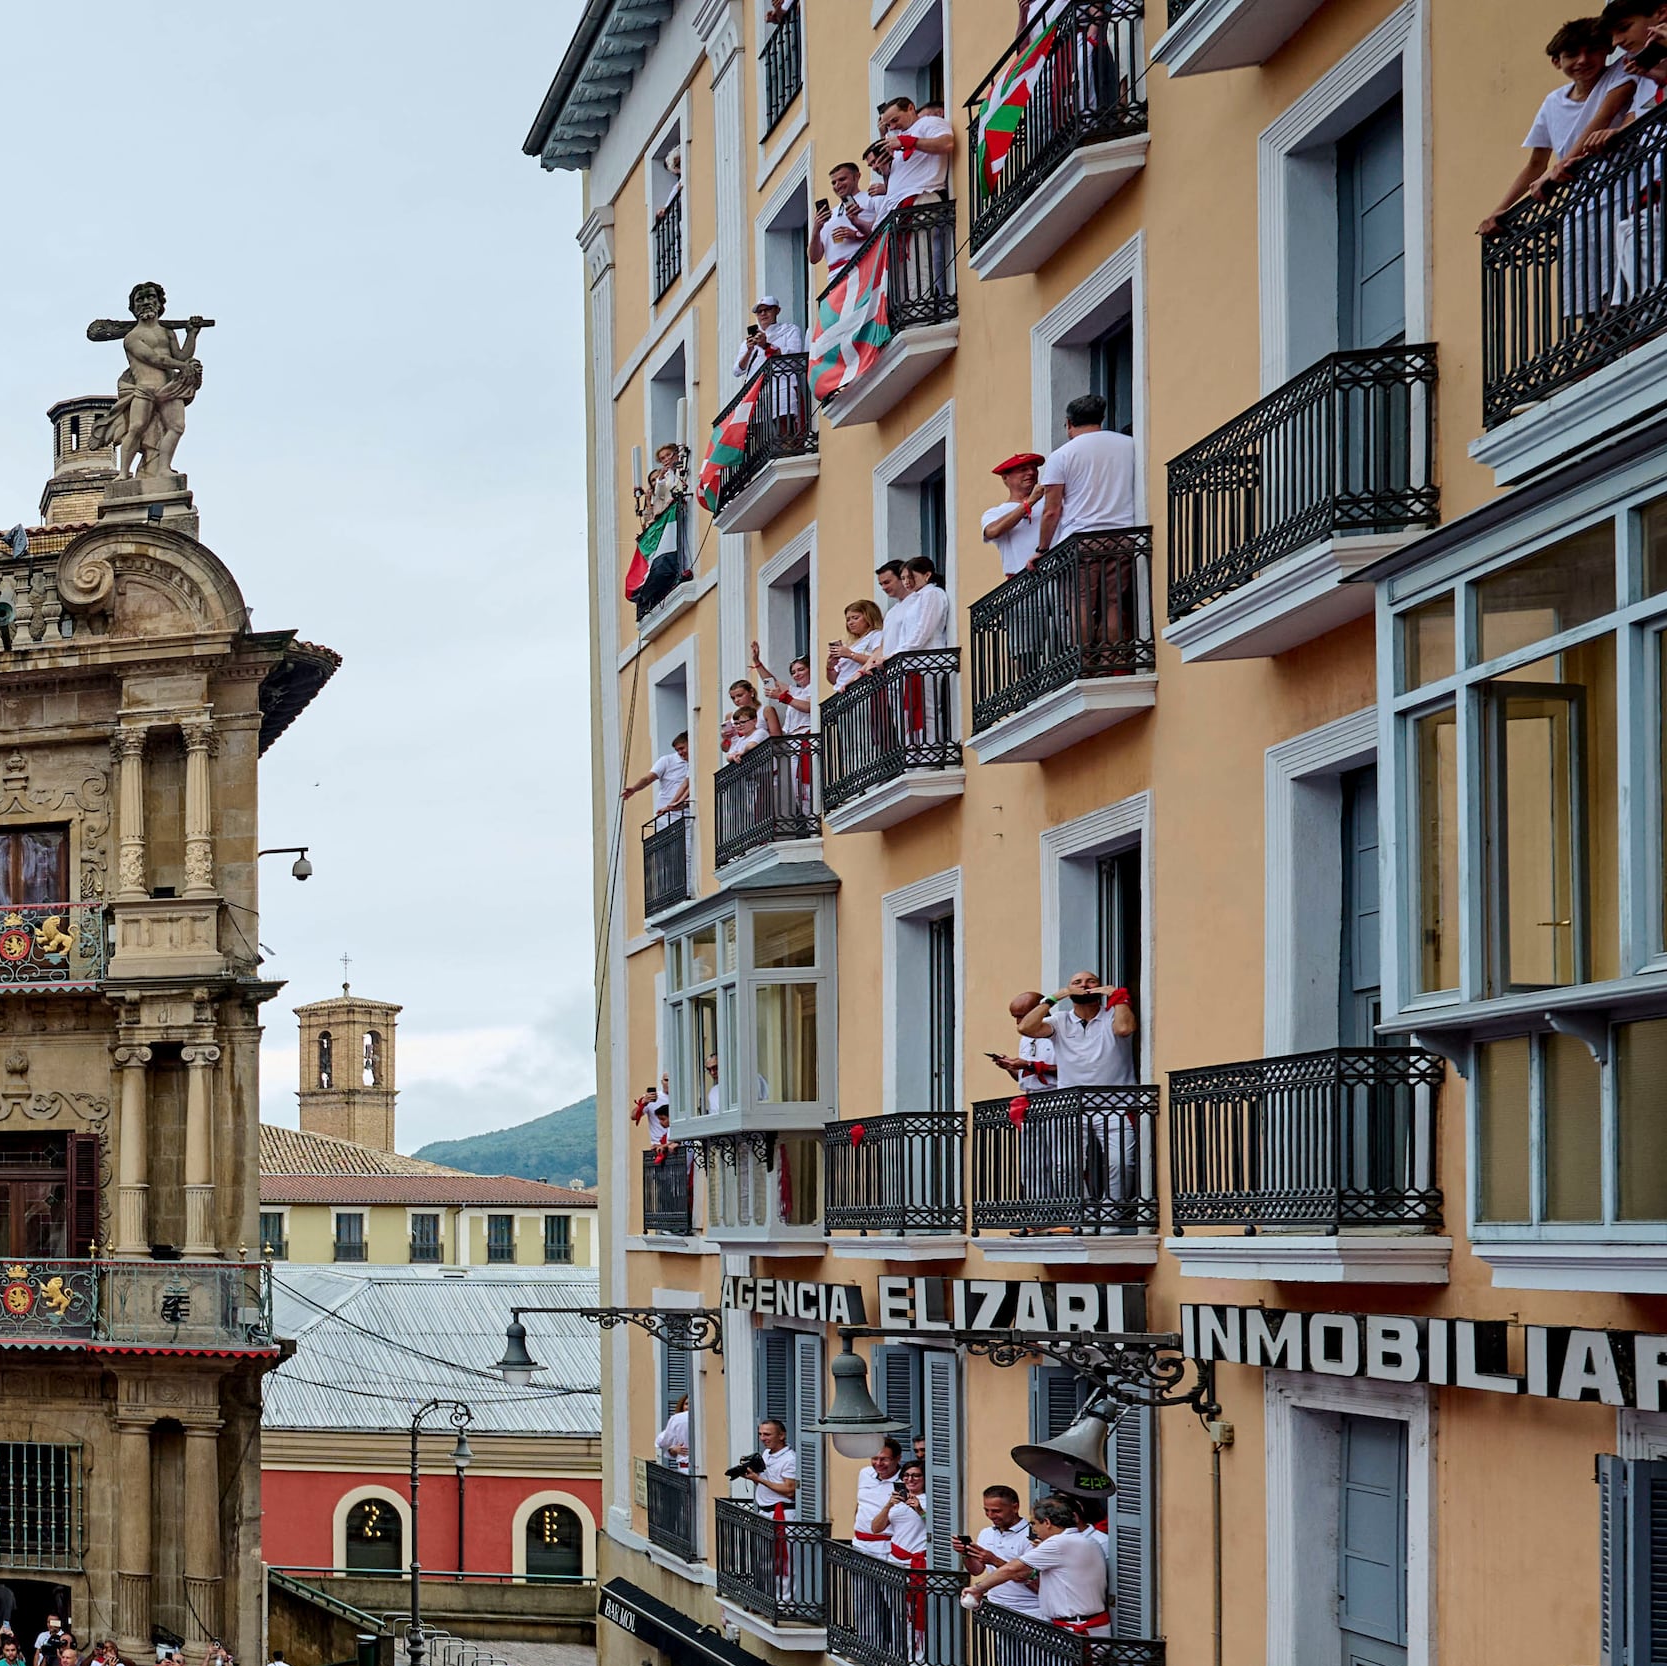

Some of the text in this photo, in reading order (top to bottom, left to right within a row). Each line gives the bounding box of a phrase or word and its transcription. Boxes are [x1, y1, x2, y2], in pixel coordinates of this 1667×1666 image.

[720, 1275, 852, 1324] AGENCIA
[878, 1275, 1126, 1334] ELIZARI
[604, 1599, 636, 1633] BAR MOL
